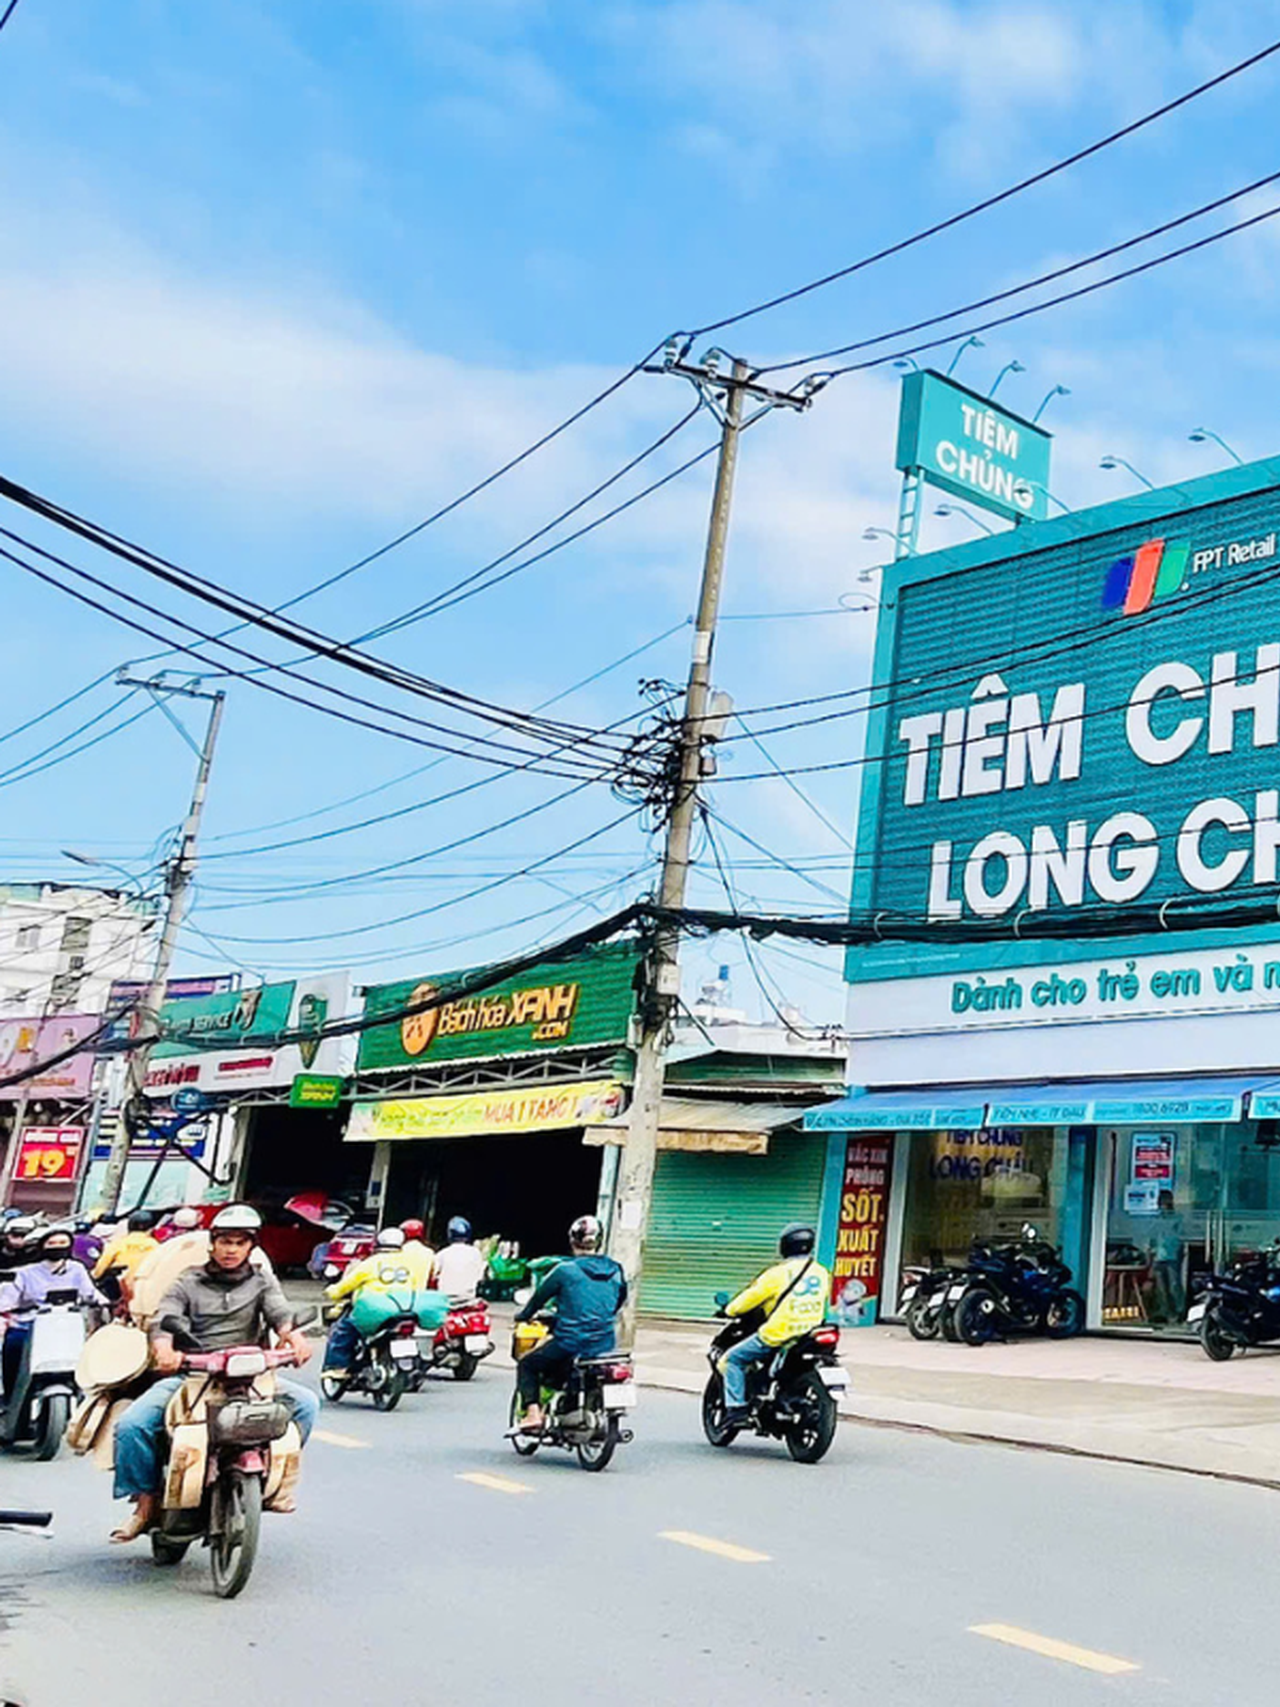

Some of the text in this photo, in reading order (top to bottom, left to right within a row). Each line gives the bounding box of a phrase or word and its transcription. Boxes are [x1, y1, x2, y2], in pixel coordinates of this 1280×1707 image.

[961, 402, 1019, 460] TIÊM
[935, 440, 1034, 509] CHỦNG
[1192, 533, 1276, 574] FPT Retail
[899, 672, 1085, 807] TIÊM
[927, 811, 1160, 924] LONG
[950, 975, 1022, 1014] Dành
[1030, 974, 1086, 1008] cho
[1097, 961, 1139, 1002] trẻ
[1150, 968, 1201, 998] em
[1212, 954, 1254, 994] và
[437, 983, 579, 1036] Bách hóa XANH
[531, 1020, 569, 1040] .COM
[21, 1149, 66, 1177] 19
[840, 1185, 882, 1223] SỐT
[836, 1223, 880, 1252] XUẤT
[834, 1251, 877, 1278] HUYẾT
